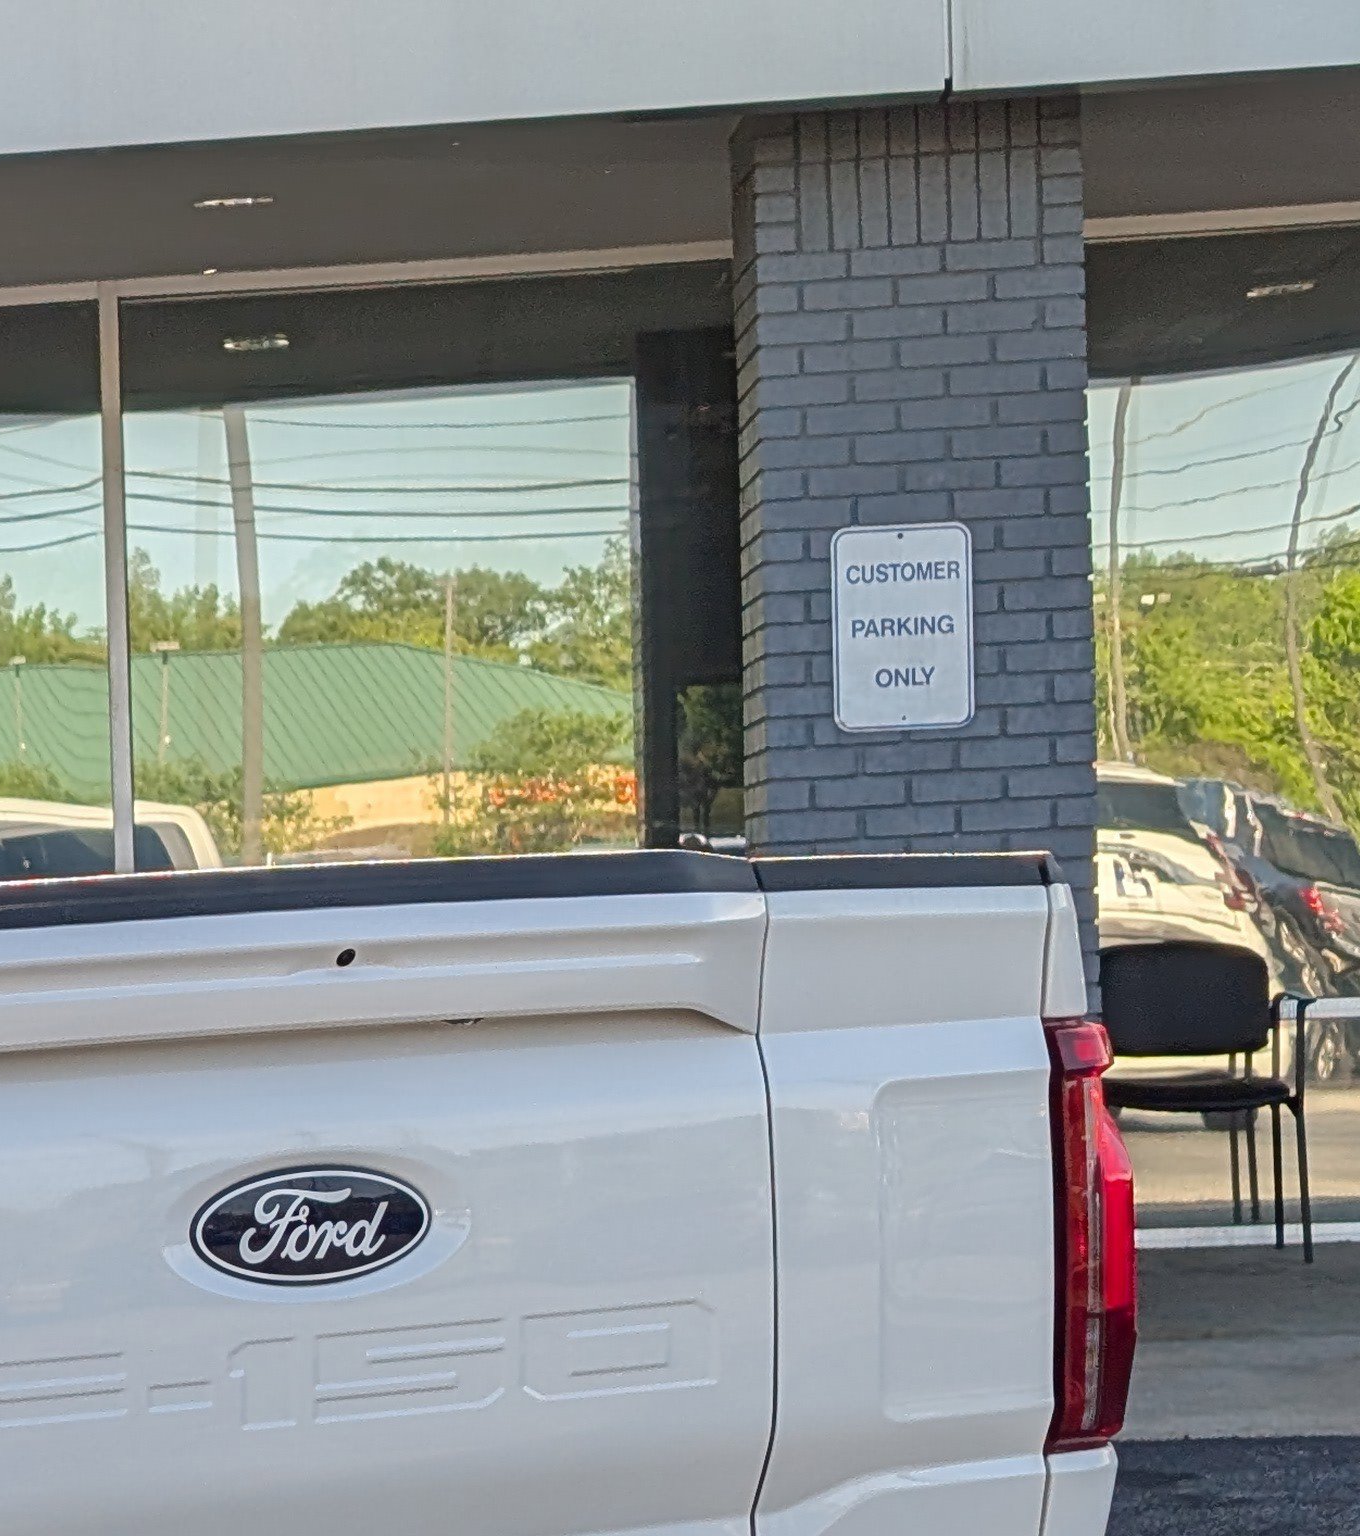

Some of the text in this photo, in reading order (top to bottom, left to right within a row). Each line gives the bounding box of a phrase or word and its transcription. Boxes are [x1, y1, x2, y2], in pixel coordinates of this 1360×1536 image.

[845, 560, 960, 585] CUSTOMER
[850, 614, 955, 638] PARKING
[875, 666, 935, 688] ONLY
[239, 1188, 387, 1265] Ford
